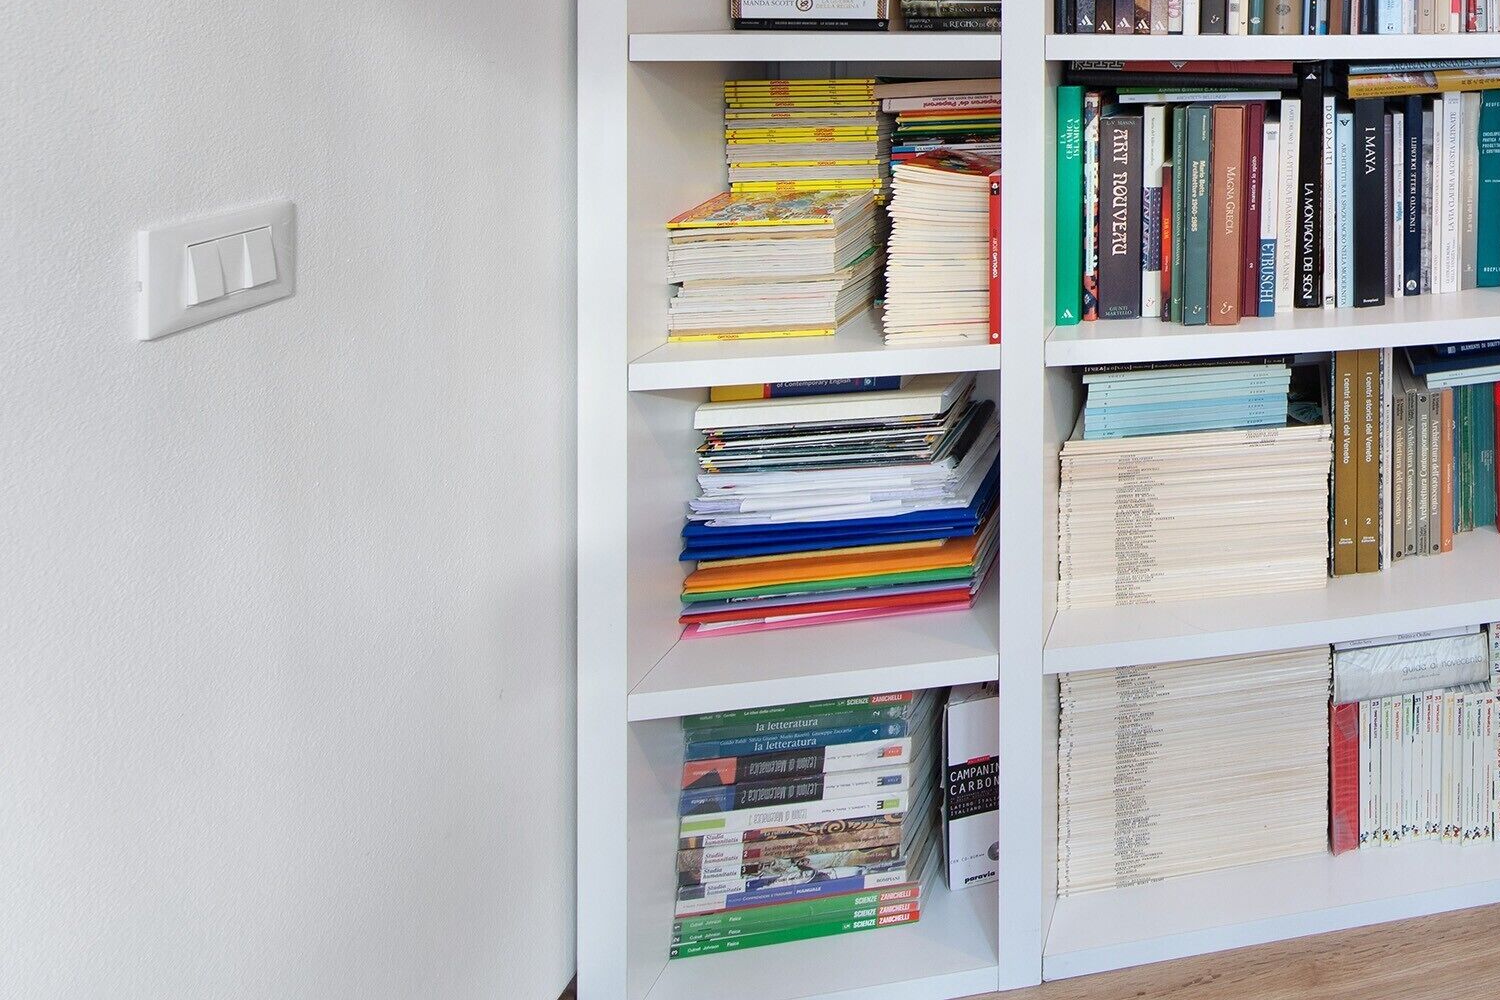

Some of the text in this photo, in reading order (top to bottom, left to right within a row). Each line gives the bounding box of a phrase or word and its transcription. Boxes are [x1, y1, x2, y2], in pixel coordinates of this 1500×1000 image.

[1060, 134, 1066, 144] LA
[1325, 105, 1333, 166] DOLOMITI
[1365, 136, 1376, 174] MAYA
[1111, 129, 1128, 256] ART NOUVEAU
[1304, 183, 1314, 195] LA
[1225, 166, 1236, 235] MAGNA GRECIA
[1190, 198, 1198, 232] 1960-1985
[1303, 197, 1314, 254] MONTAGNA
[1261, 243, 1275, 303] ETRUSCHI
[1303, 274, 1313, 299] SEGNI
[785, 379, 826, 388] Contemporary
[1342, 377, 1350, 398] centri
[1365, 376, 1373, 397] centri
[1342, 400, 1350, 421] storici
[1365, 399, 1373, 420] storici
[1342, 423, 1350, 435] del
[1365, 422, 1373, 434] del
[1342, 437, 1350, 464] Veneto
[1365, 436, 1373, 462] Veneto
[847, 694, 902, 706] SCIENZE ZANICHELLI
[756, 718, 818, 731] la letteratura
[754, 738, 817, 751] la letteratura
[964, 871, 996, 884] paravia
[854, 890, 912, 905] SCIENZE ZANICHELLI
[854, 903, 911, 918] SCIENZE ZANICHELLI
[853, 914, 910, 929] SCIENZE ZANICHELLI
